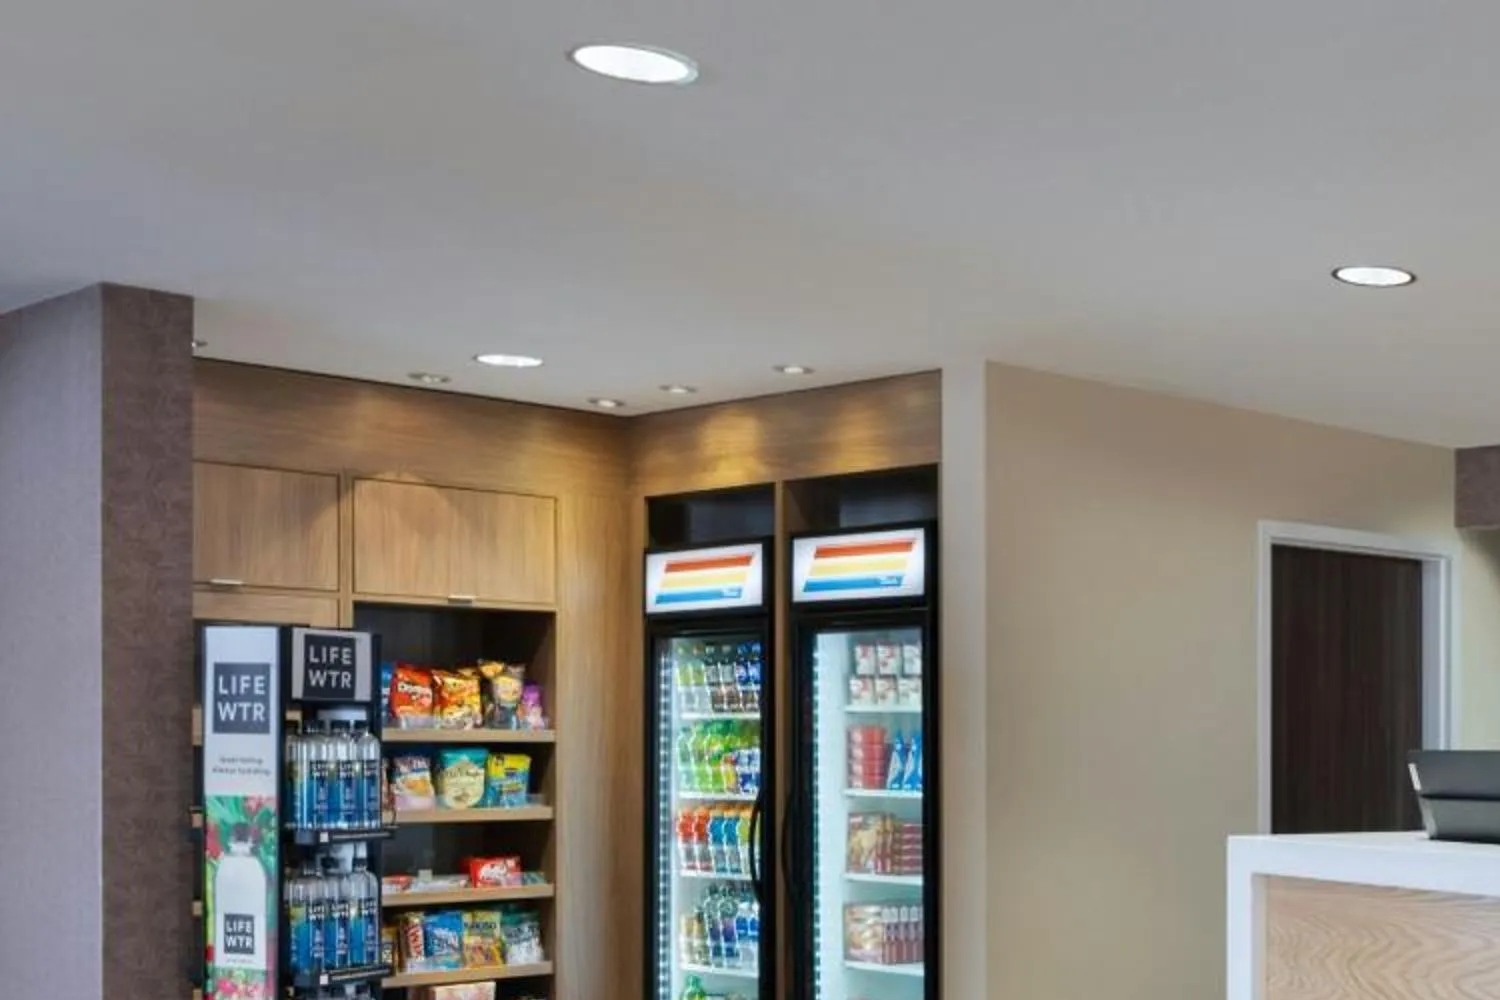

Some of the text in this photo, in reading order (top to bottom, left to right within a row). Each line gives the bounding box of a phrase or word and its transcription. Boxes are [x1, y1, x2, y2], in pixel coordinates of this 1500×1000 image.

[307, 645, 352, 665] LIFE
[219, 675, 266, 696] LIFE
[308, 669, 352, 689] WTR
[217, 701, 266, 722] WTR
[225, 920, 252, 933] LIFE
[225, 935, 253, 949] WTR
